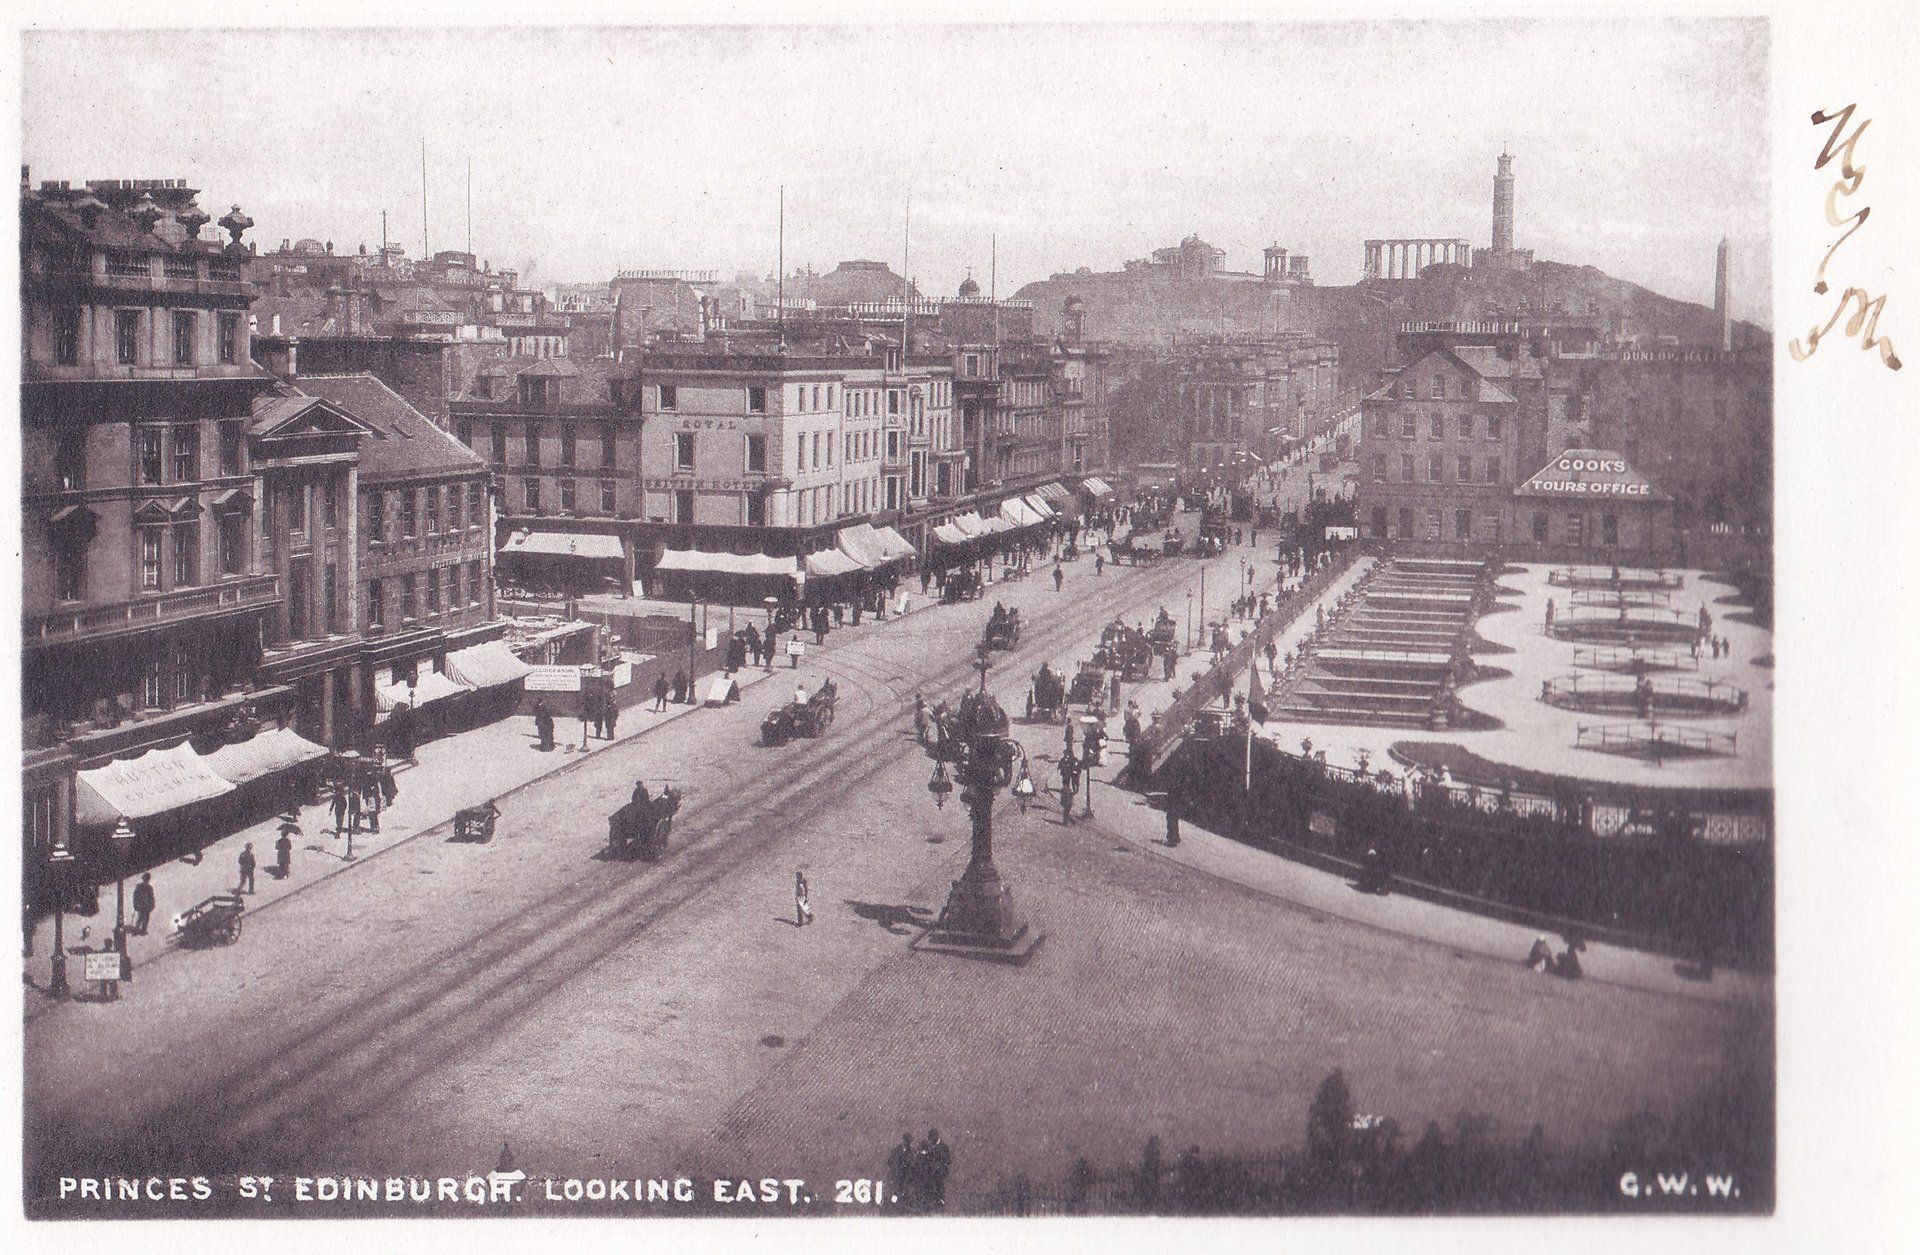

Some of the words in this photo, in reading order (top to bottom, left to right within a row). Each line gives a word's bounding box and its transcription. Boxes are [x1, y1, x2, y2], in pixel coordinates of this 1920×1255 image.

[682, 420, 737, 430] ROYAL
[1558, 459, 1626, 473] COOK'S
[712, 480, 761, 491] HOTEL
[1531, 480, 1587, 492] TOURS
[1590, 482, 1650, 495] OFFICE
